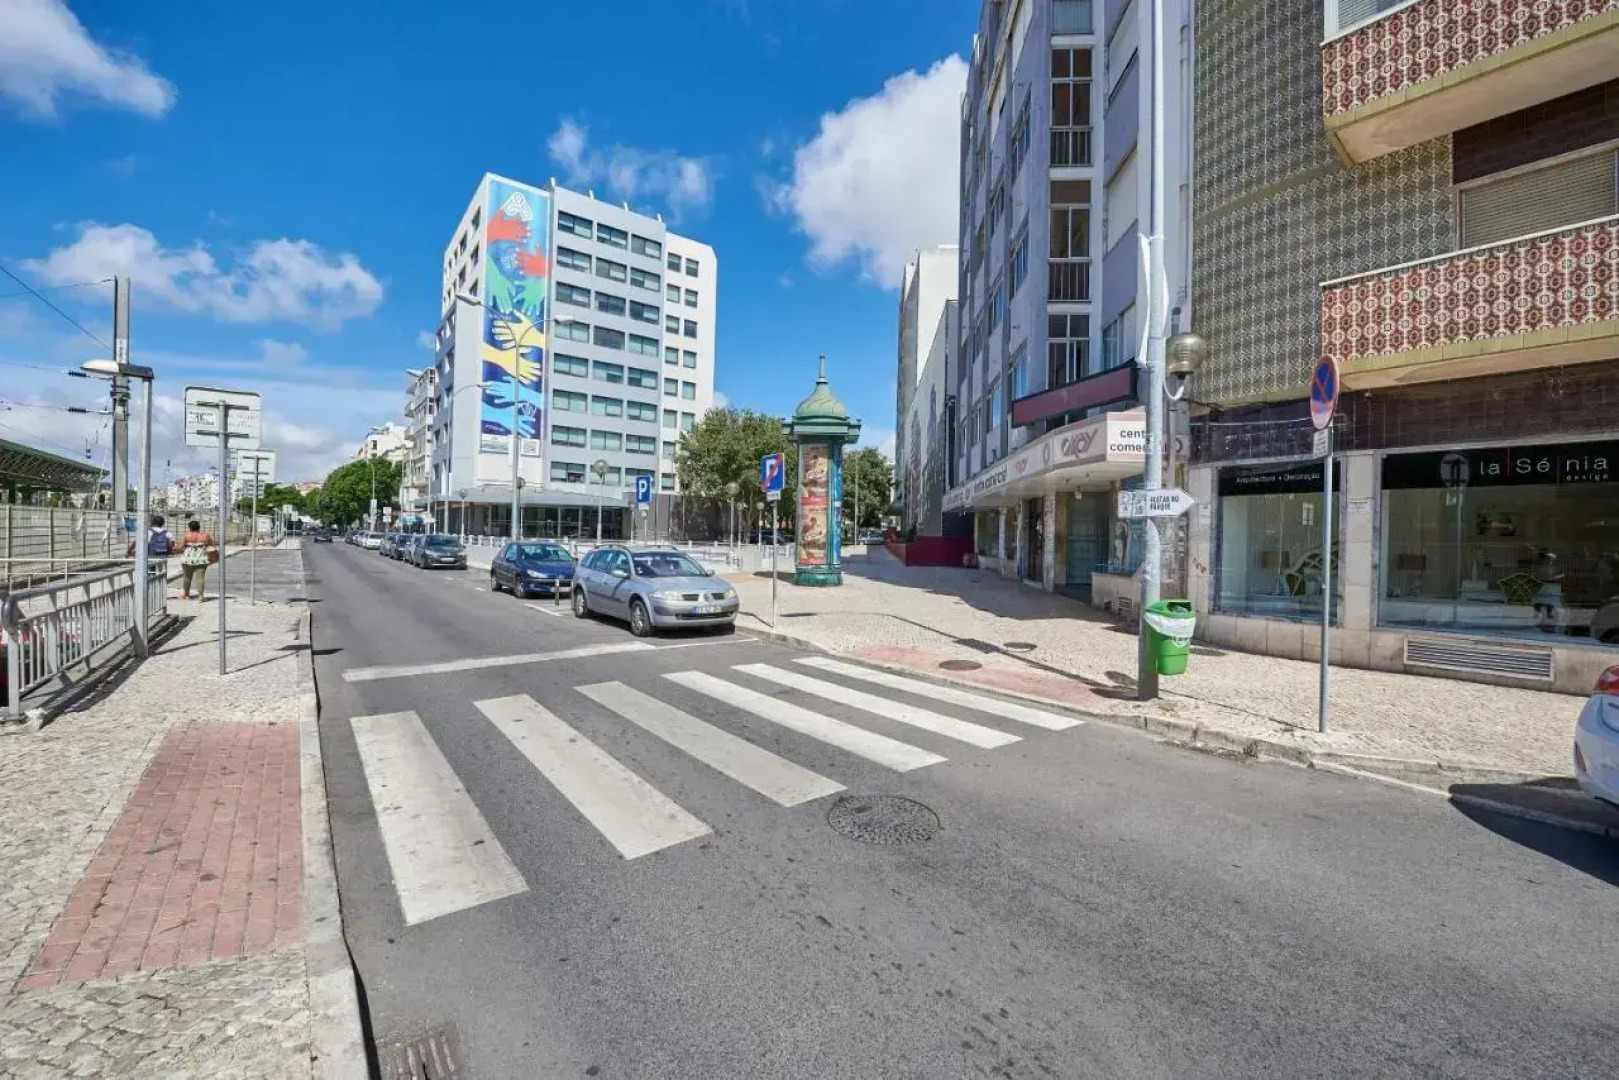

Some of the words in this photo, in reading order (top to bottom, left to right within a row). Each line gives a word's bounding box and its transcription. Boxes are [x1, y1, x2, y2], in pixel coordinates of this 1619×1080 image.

[1120, 429, 1146, 439] cent
[1480, 460, 1500, 475] la
[1515, 457, 1550, 474] Sé
[1566, 455, 1609, 472] nia
[638, 478, 648, 500] P
